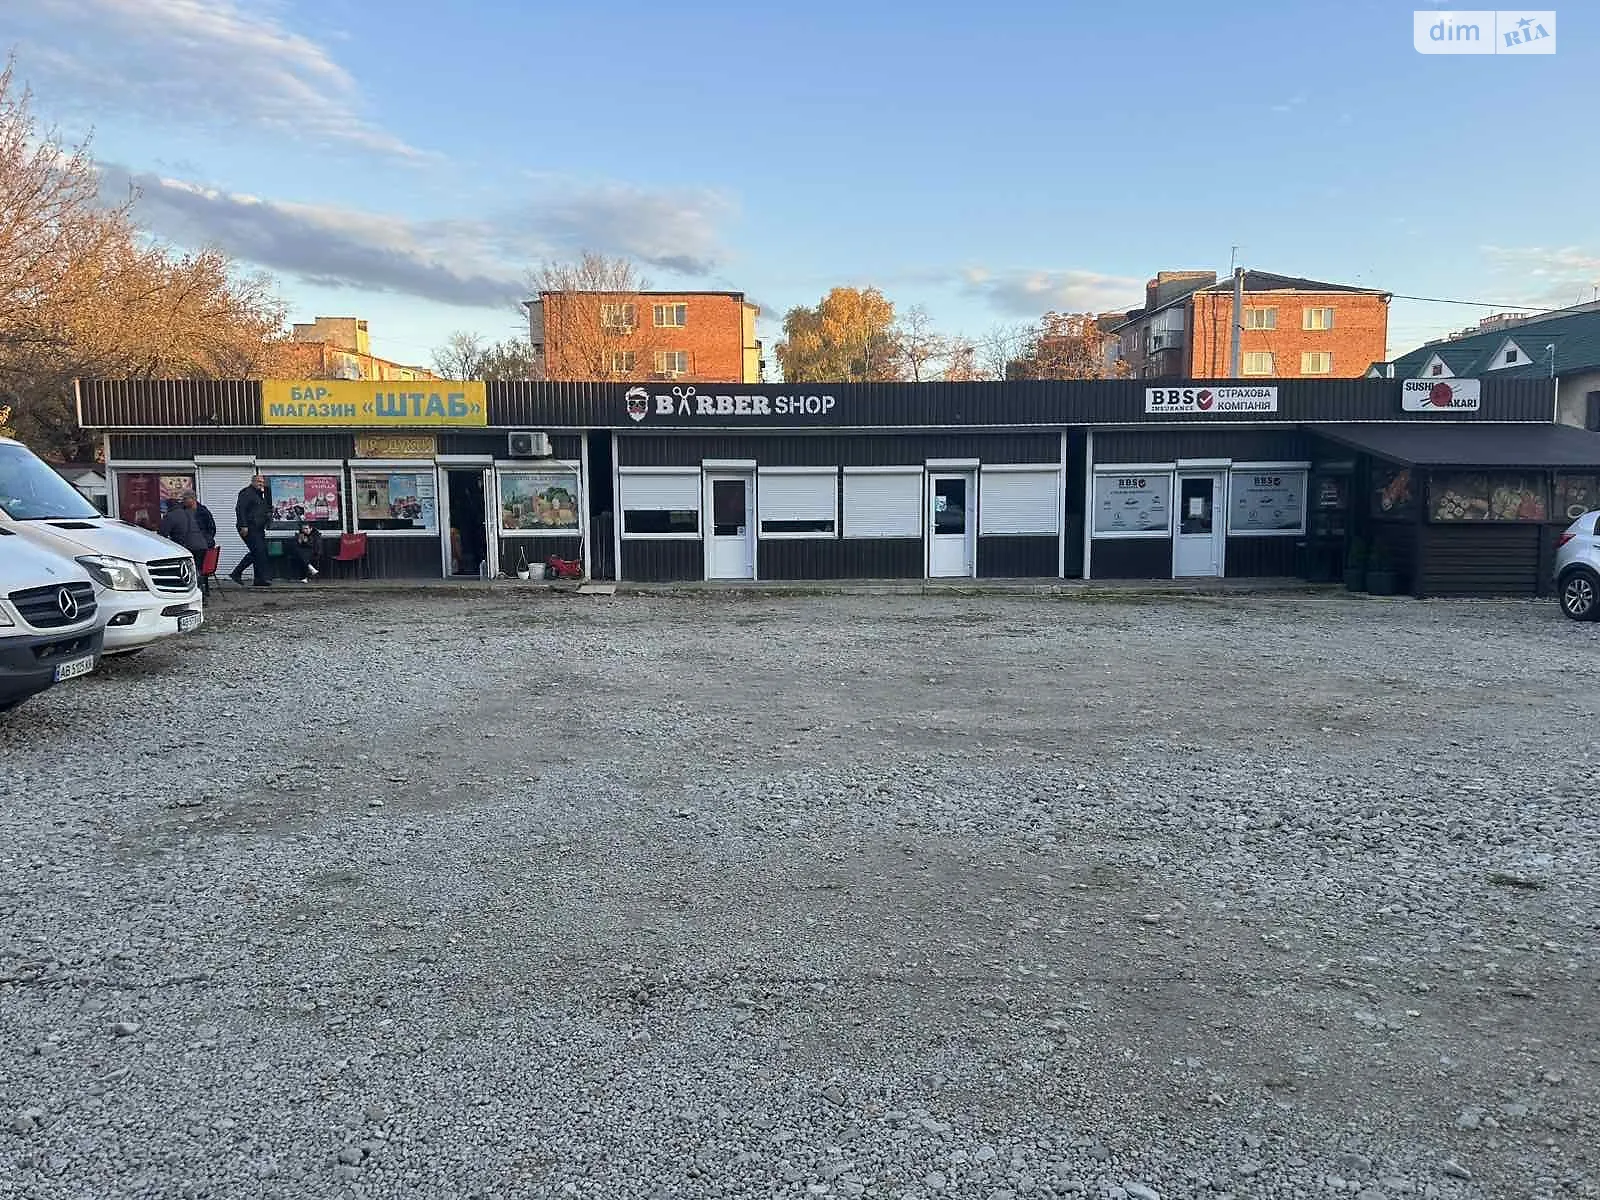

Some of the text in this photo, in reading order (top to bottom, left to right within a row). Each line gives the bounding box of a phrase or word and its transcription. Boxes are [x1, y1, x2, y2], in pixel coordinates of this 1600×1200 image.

[290, 387, 333, 401] БАР-
[1217, 388, 1271, 398] СТРАХОВА
[1405, 382, 1435, 392] SUSHI
[1151, 389, 1195, 405] BBS
[269, 392, 481, 417] МАГАЗИН «ШТАБ»
[774, 395, 836, 416] SHOP
[1217, 401, 1271, 411] КОМПАНІЯ
